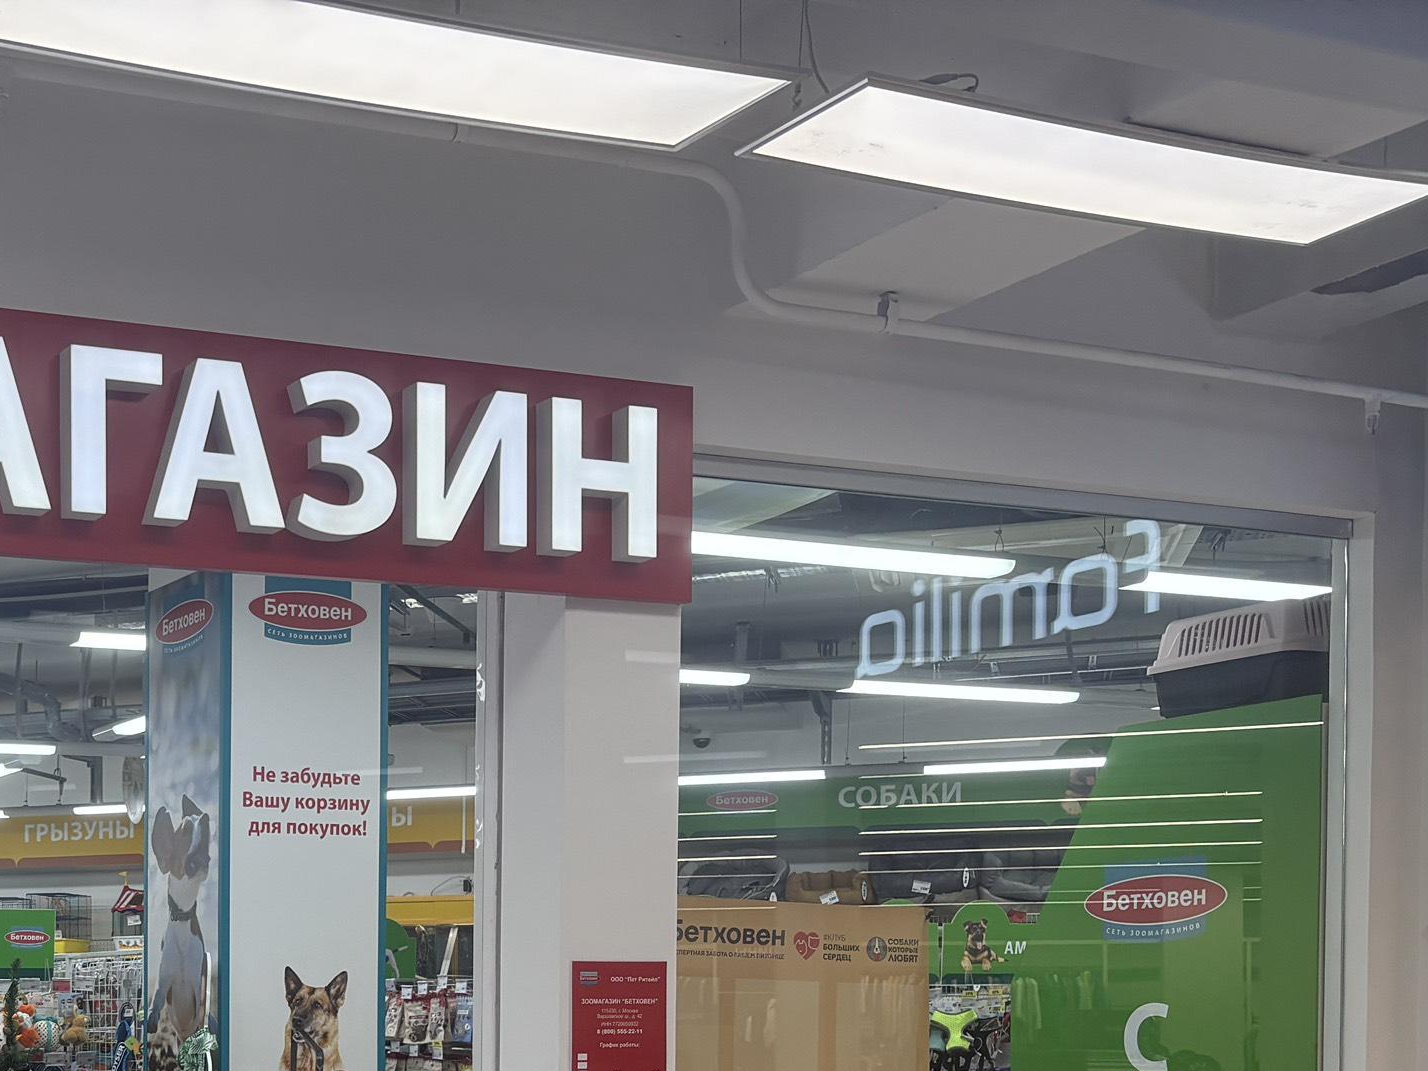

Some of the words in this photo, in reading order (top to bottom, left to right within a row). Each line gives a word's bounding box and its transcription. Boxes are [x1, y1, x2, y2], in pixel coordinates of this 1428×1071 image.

[264, 598, 352, 621] Бетховен
[161, 607, 206, 637] Бетховен
[288, 632, 348, 641] ЗООМАГАЗИНОВ
[252, 766, 276, 782] Не
[280, 767, 361, 788] забудьте
[242, 791, 291, 812] Вашу
[295, 796, 371, 815] корзину
[714, 791, 770, 808] Бетховен
[838, 781, 962, 809] СОБАКИ
[23, 819, 135, 843] ГРЫЗУНЫ
[248, 820, 281, 837] для
[285, 820, 368, 839] покупок!
[1102, 888, 1207, 912] Бетховен
[9, 932, 46, 942] Бетховен
[1129, 923, 1201, 937] ЗООМАГАЗИНОВ
[823, 943, 860, 952] БОЛЬШИХ
[888, 938, 919, 946] СОБАКИ
[823, 953, 851, 963] СЕРДЕЦ
[888, 954, 918, 963] ЛЮБЯТ
